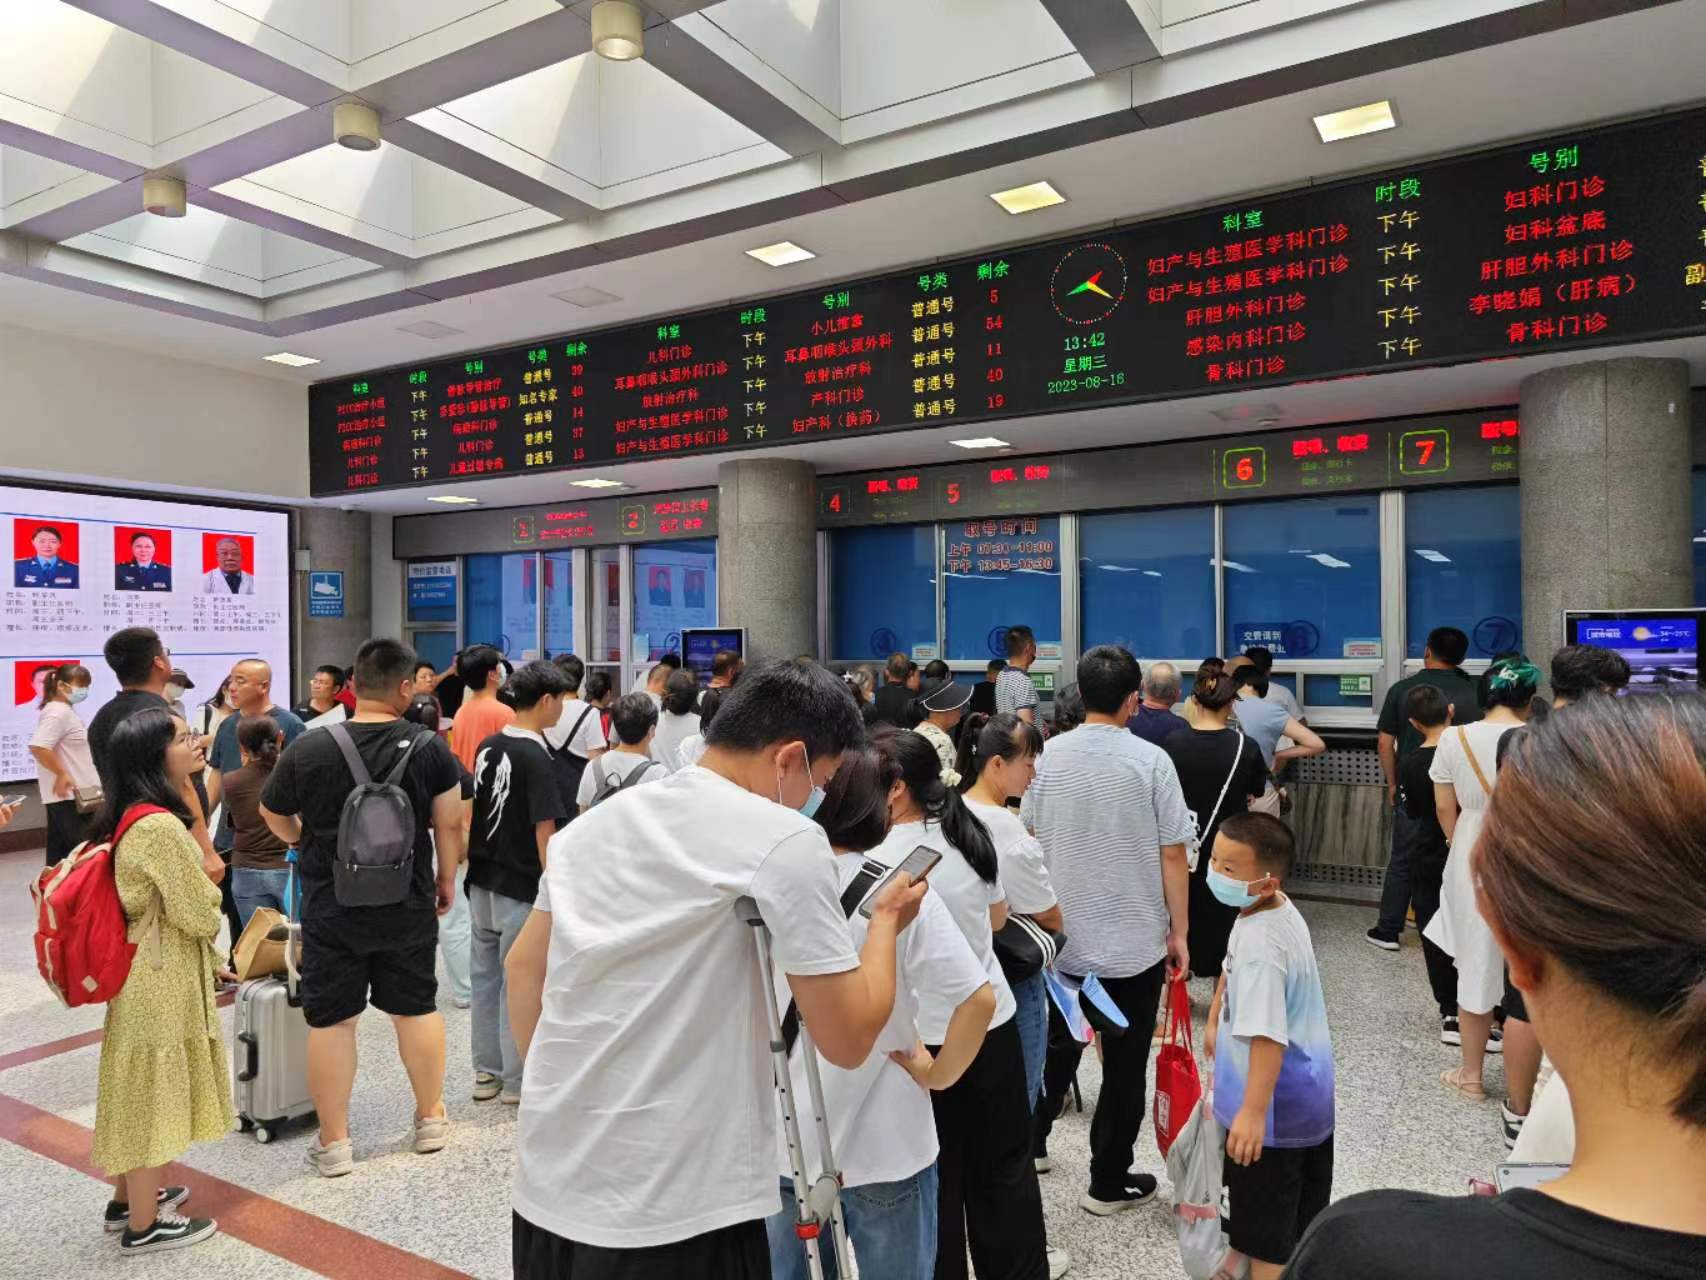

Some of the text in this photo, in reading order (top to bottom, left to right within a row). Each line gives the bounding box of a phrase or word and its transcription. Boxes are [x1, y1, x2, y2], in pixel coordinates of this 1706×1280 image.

[1528, 144, 1580, 174] 号别
[1375, 177, 1422, 204] 时段
[1503, 175, 1606, 212] 妇科门诊
[1222, 209, 1264, 233] 科室
[1376, 210, 1420, 234] 下午
[1503, 209, 1607, 246] 妇科盆底
[1147, 224, 1350, 276] 妇产与生殖医学科门诊
[1376, 241, 1421, 265] 下午
[1479, 239, 1634, 282] 肝胆外科门诊
[976, 260, 1010, 281] 剩余
[1147, 254, 1350, 305] 妇产与生殖医学科门诊
[916, 273, 948, 292] 号类
[1377, 273, 1422, 297] 下午
[821, 290, 850, 310] 号别
[911, 296, 954, 319] 普通号
[989, 289, 998, 305] 5
[741, 307, 767, 325] 时段
[1184, 291, 1307, 327] 肝胆外科门诊
[1377, 305, 1422, 329] 下午
[656, 325, 681, 341] 科室
[911, 322, 956, 344] 普通号
[986, 315, 1003, 331] 54
[1506, 311, 1608, 344] 骨科门诊
[742, 330, 767, 348] 下午
[1064, 332, 1106, 351] 13:42
[1184, 321, 1307, 356] 感染内科门诊
[1377, 336, 1423, 361] 下午
[646, 344, 693, 365] 儿科门诊
[911, 348, 956, 369] 普通号
[986, 342, 1003, 357] 11
[742, 354, 767, 371] 下午
[803, 360, 873, 386] 放射治疗科
[1064, 354, 1108, 373] 星期三
[1204, 354, 1287, 383] 骨科门诊
[523, 368, 552, 384] 普通号
[912, 373, 956, 395] 普通号
[986, 367, 1004, 383] 40
[1048, 372, 1126, 394] 2023-08-16
[411, 390, 429, 403] 下午
[519, 387, 558, 406] 知名专家
[743, 377, 767, 395] 下午
[810, 386, 865, 408] 产科门诊
[987, 393, 1004, 409] 19
[411, 409, 429, 422] 下午
[523, 410, 553, 426] 普通号
[744, 400, 768, 418] 下午
[912, 397, 957, 419] 普通号
[411, 428, 429, 441] 下午
[524, 430, 553, 446] 普通号
[744, 423, 768, 441] 下午
[412, 447, 429, 460] 下午
[525, 450, 553, 467] 普通号
[1414, 439, 1436, 466] 7
[412, 466, 429, 480] 下午
[1235, 457, 1254, 481] 6
[829, 493, 842, 513] 4
[946, 483, 961, 504] 5
[964, 517, 1037, 538] 取号时间
[948, 543, 972, 557] 上午
[948, 559, 972, 574] 下午
